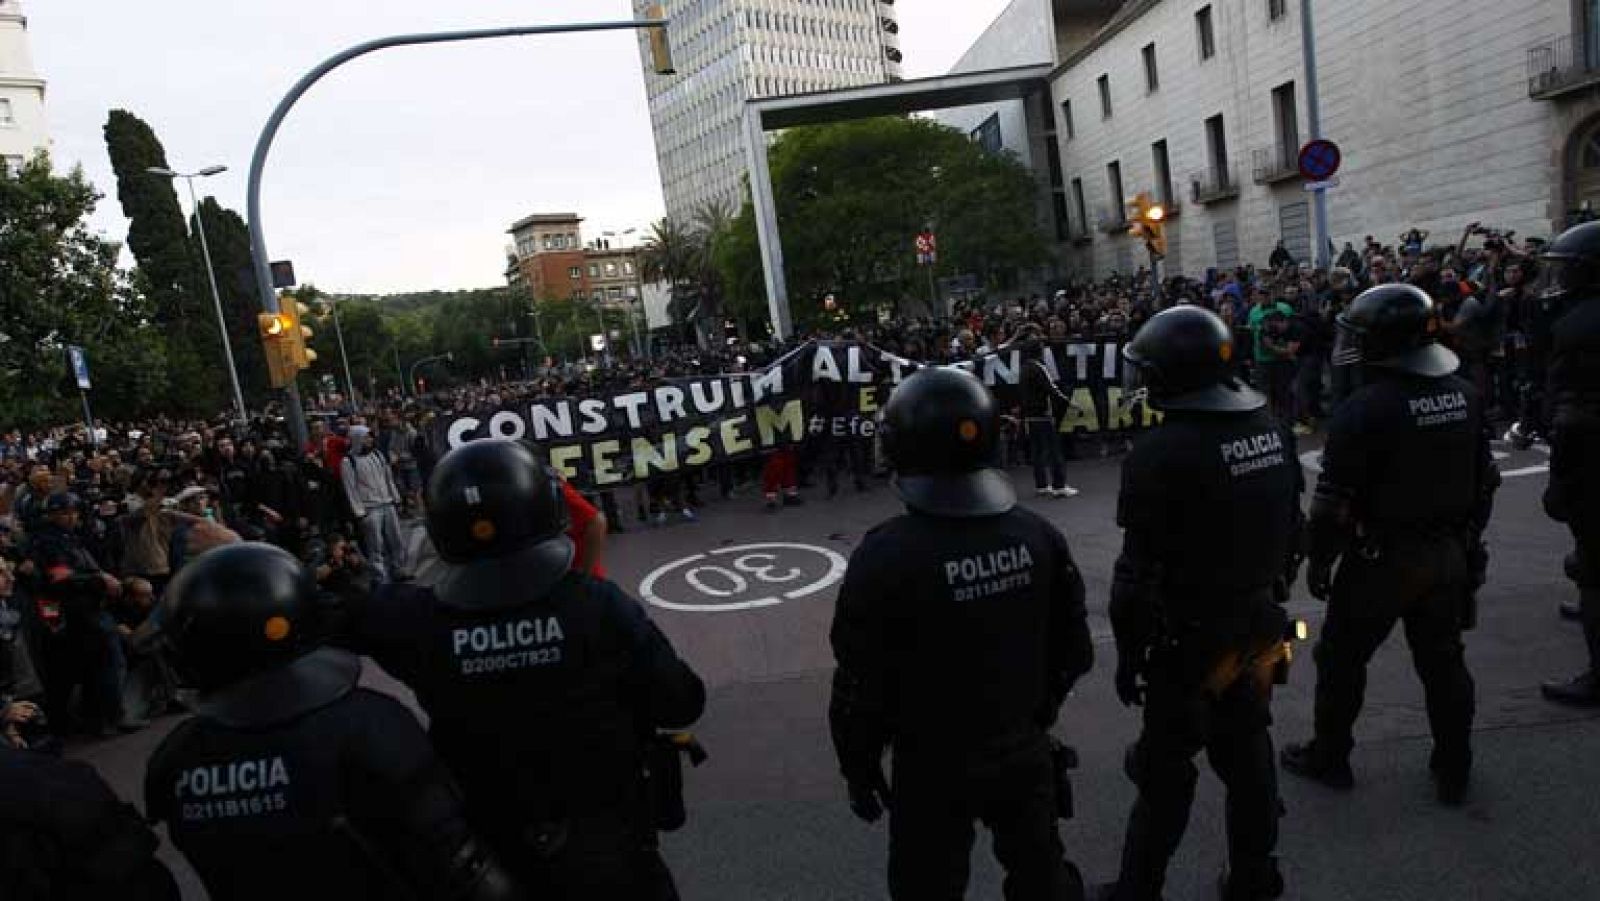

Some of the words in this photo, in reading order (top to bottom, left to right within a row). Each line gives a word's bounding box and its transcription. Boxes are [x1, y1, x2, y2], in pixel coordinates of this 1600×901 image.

[447, 366, 783, 450] CONSTRUIM
[1407, 391, 1468, 416] POLICIA
[1220, 431, 1283, 464] POLICIA
[685, 553, 801, 597] 30
[943, 544, 1035, 585] POLICIA
[451, 616, 567, 656] POLICIA
[174, 755, 291, 799] POLICIA
